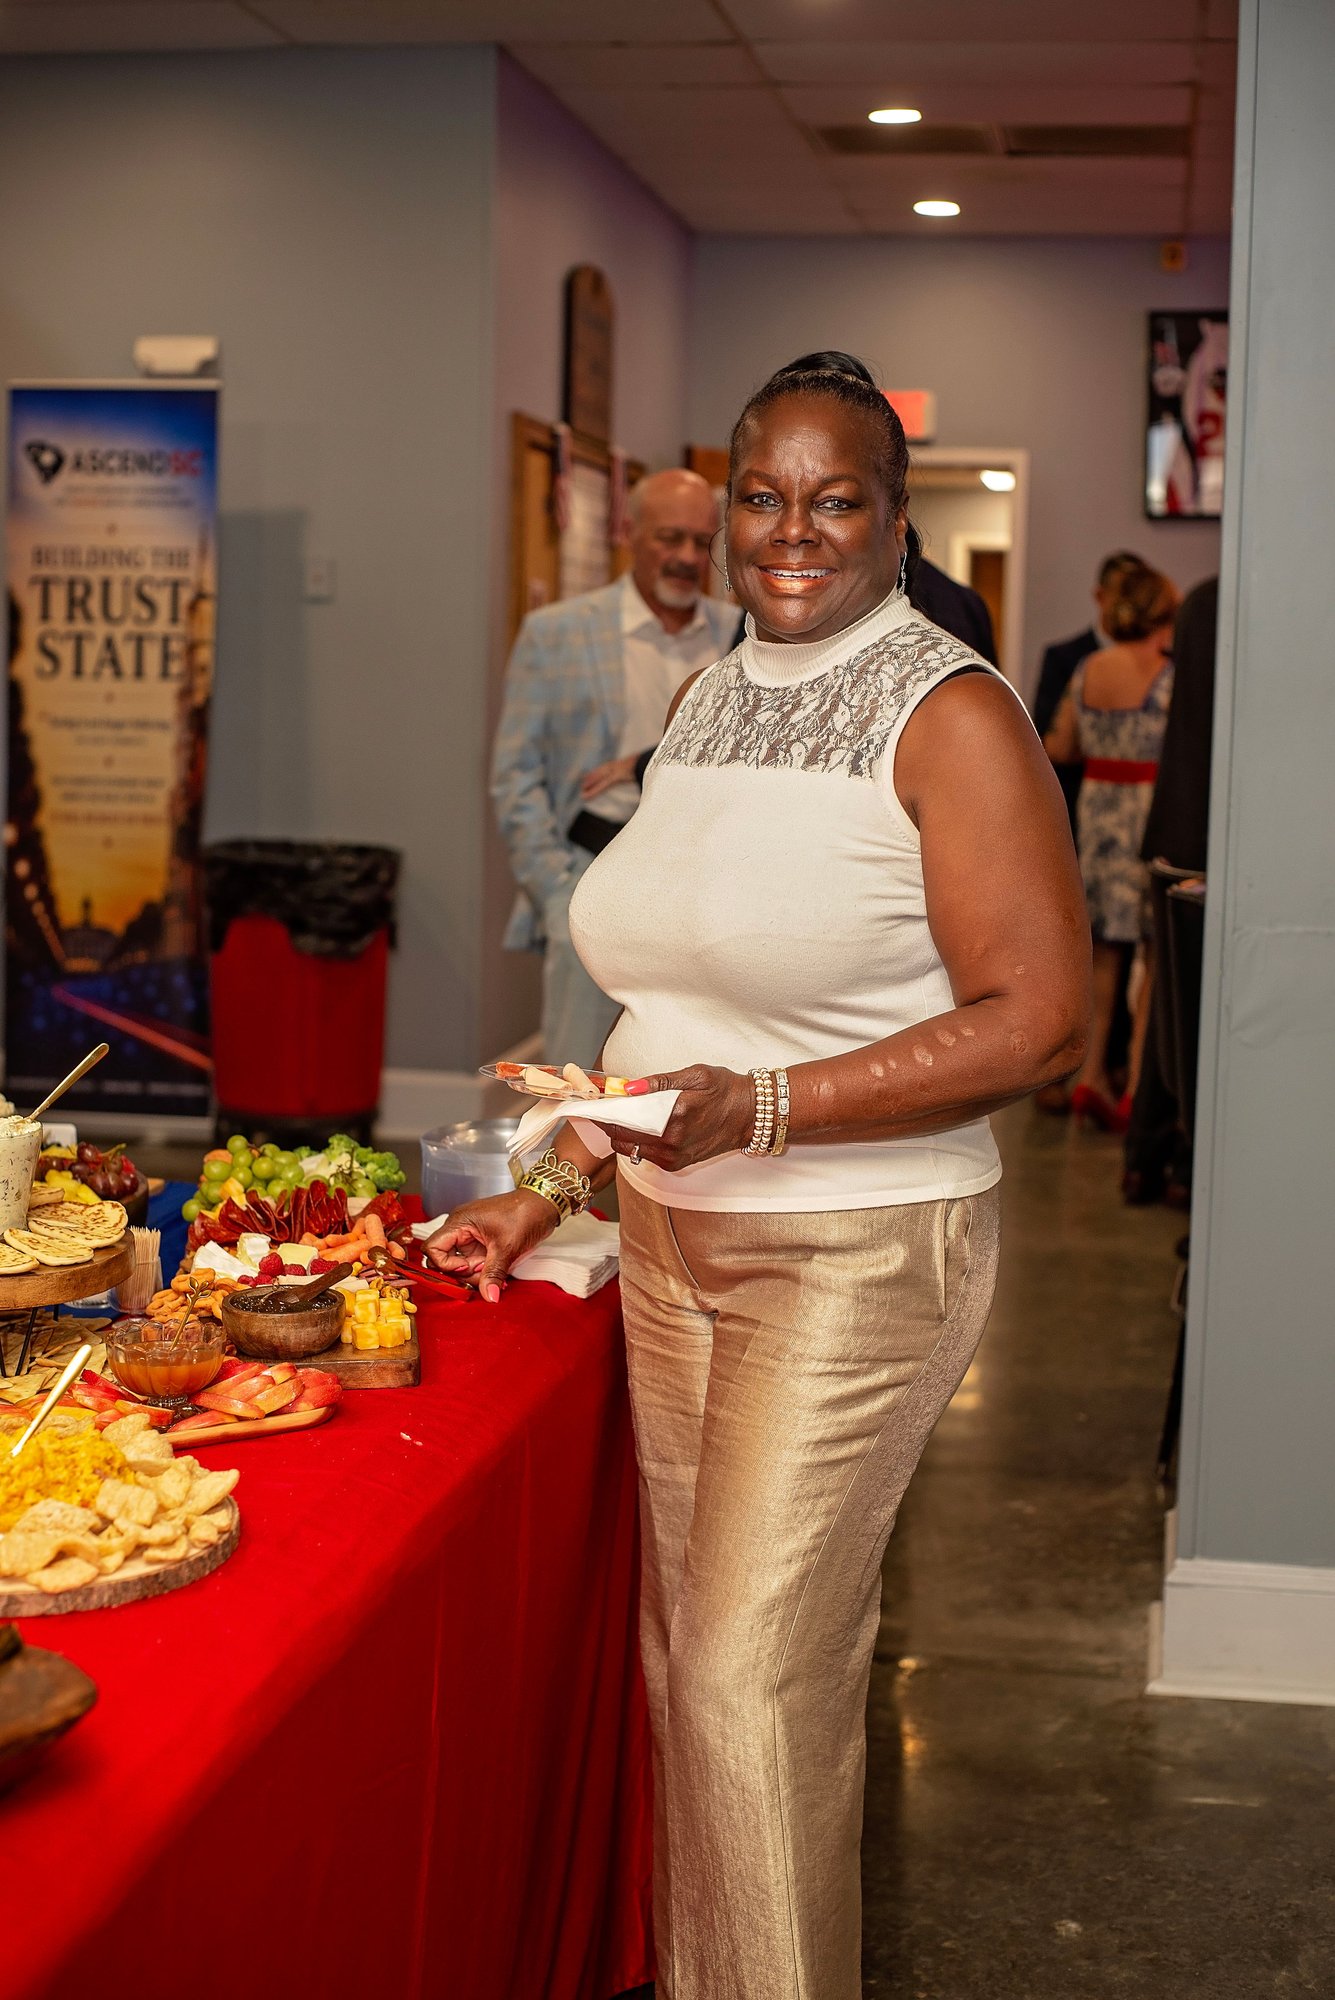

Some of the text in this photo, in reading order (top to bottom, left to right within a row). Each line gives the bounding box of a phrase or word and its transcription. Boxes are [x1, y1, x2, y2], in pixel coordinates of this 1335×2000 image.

[32, 546, 190, 569] BUILDING THE
[28, 575, 190, 626] TRUST
[35, 629, 186, 681] STATE
